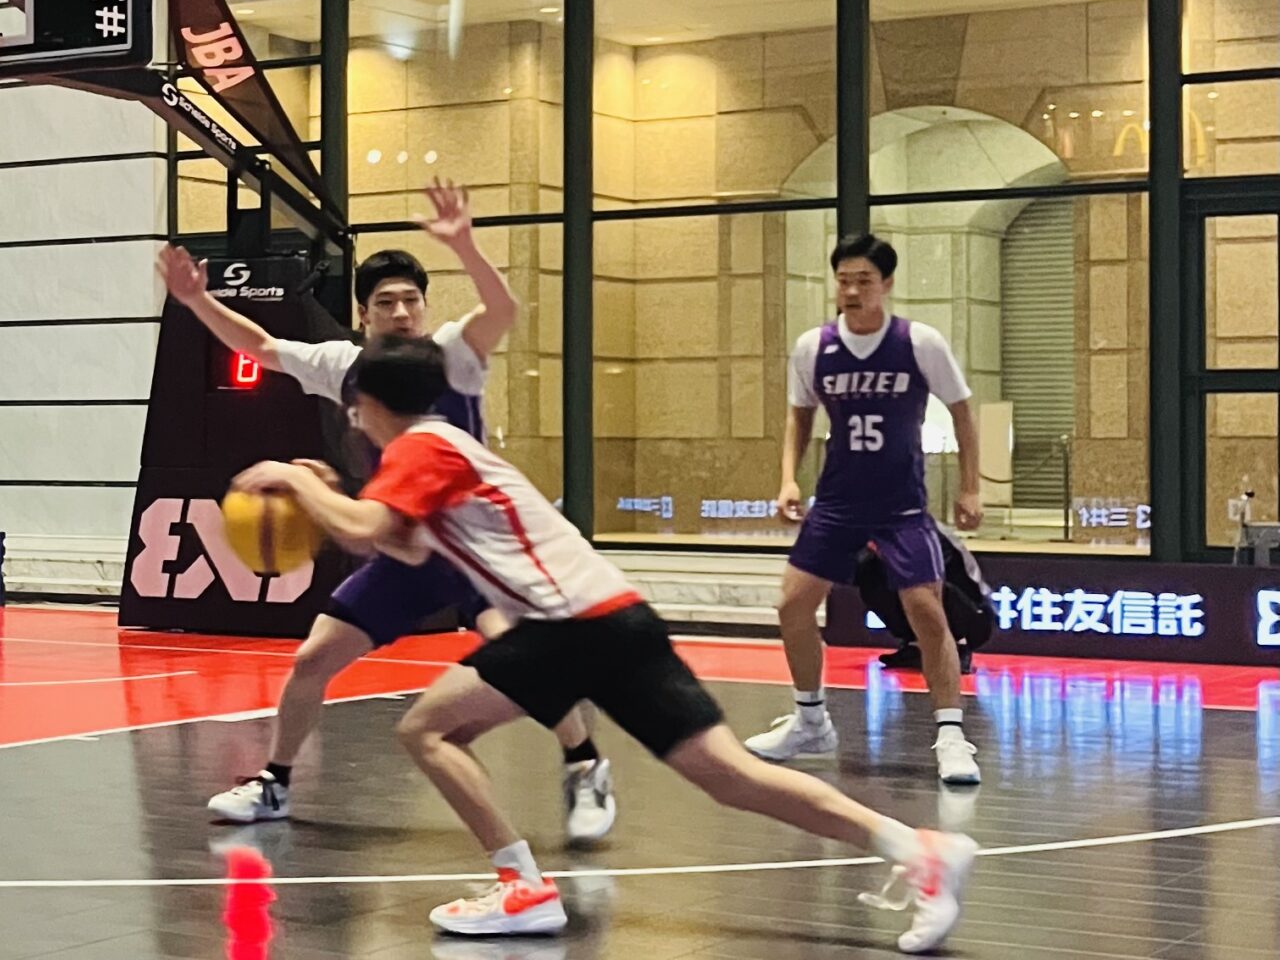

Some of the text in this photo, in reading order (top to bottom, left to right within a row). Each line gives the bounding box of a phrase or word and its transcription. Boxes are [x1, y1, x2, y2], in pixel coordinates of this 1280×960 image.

[180, 21, 256, 94] JBA
[239, 286, 284, 298] Sports
[847, 414, 884, 452] 25
[992, 585, 1206, 638] 井住友信託
